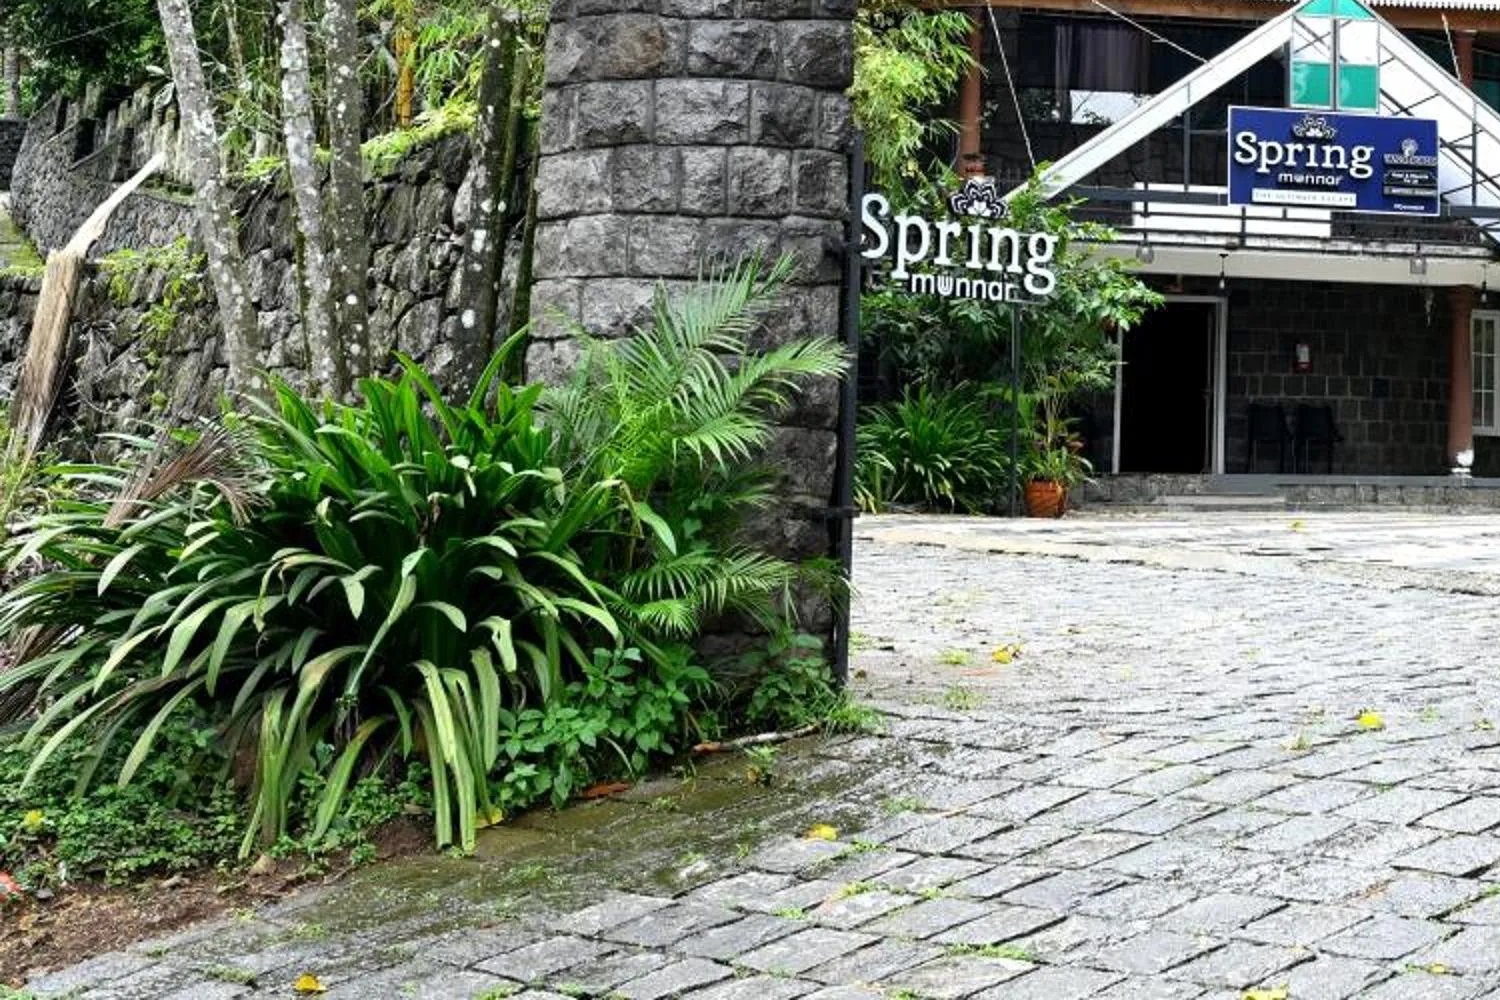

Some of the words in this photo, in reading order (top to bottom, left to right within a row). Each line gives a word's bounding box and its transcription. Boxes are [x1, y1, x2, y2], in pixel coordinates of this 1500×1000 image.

[1235, 131, 1375, 178] Spring
[1278, 172, 1343, 186] munnar
[861, 193, 1059, 295] Spring
[911, 273, 1017, 301] munnar
